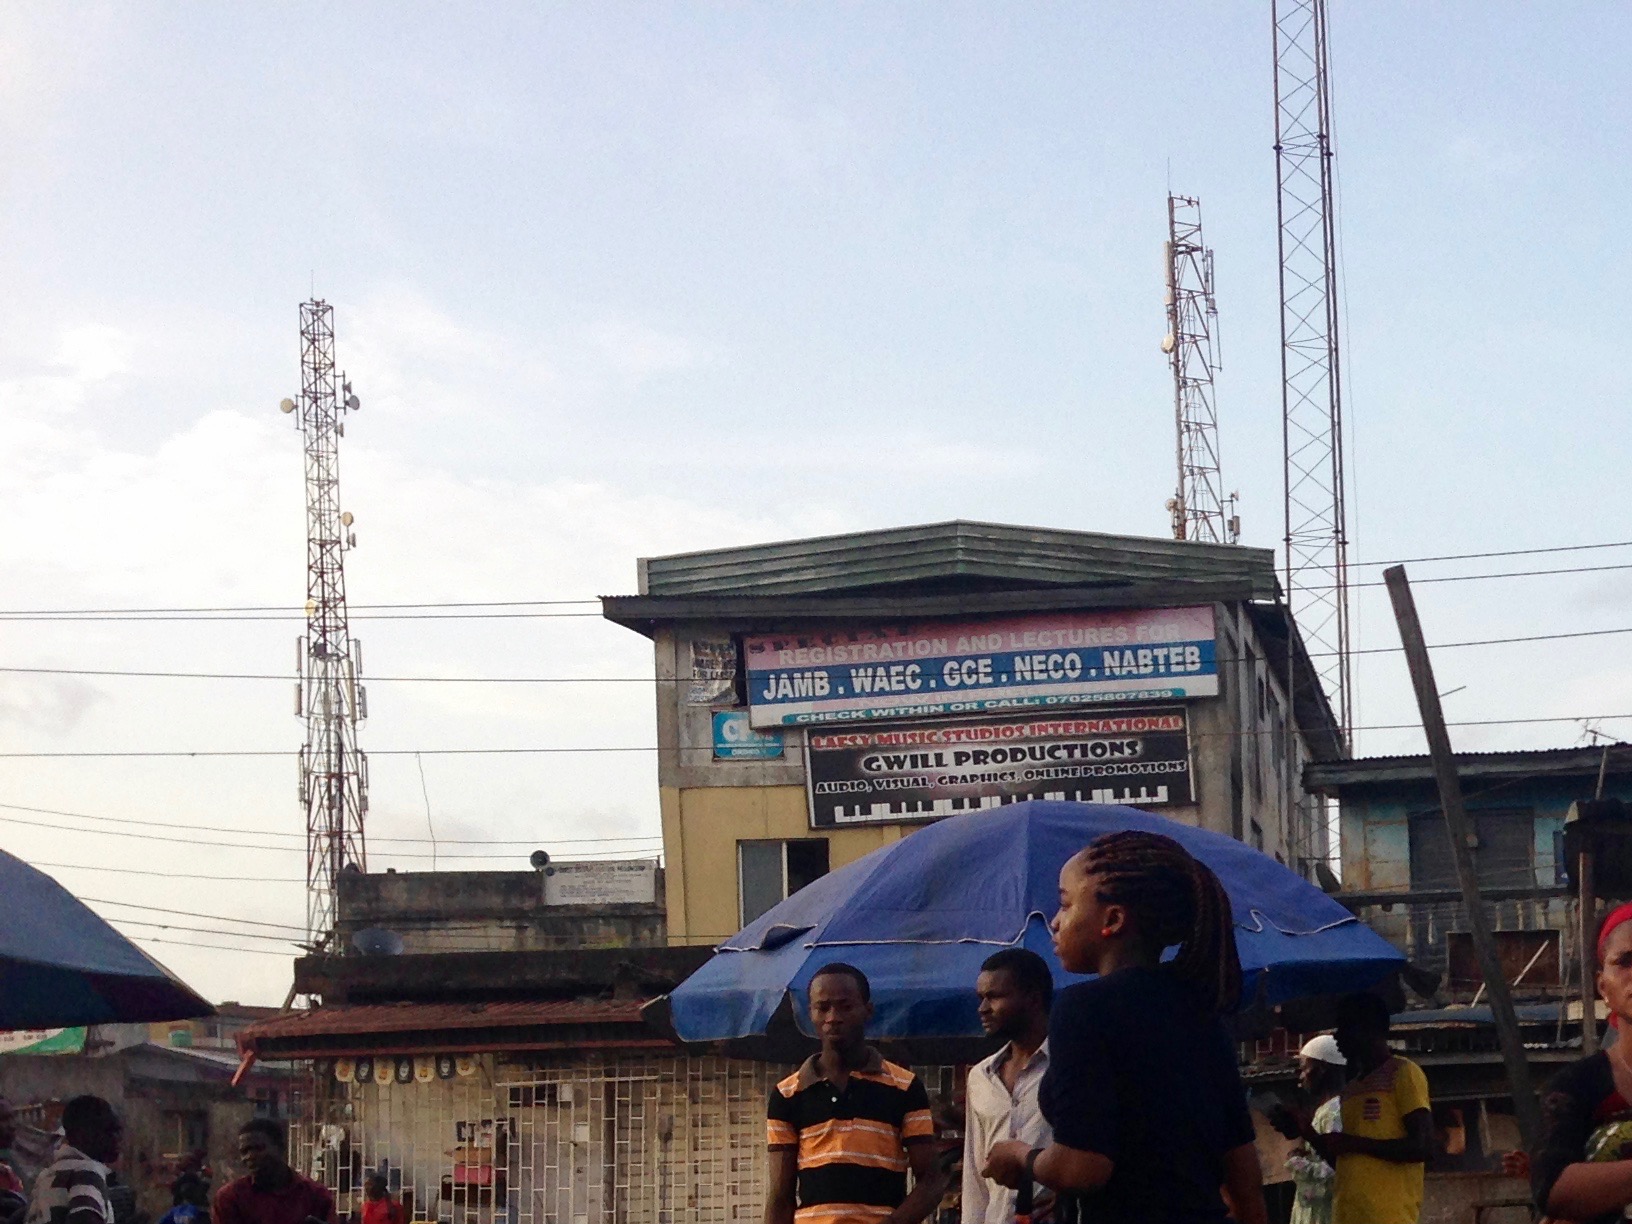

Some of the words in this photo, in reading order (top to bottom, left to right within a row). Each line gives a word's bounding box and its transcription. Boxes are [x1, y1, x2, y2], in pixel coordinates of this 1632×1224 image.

[779, 638, 948, 666] REGISTRATION
[956, 634, 1001, 654] AND
[1009, 626, 1130, 648] LECTURES
[1135, 624, 1180, 642] FOR
[763, 671, 830, 700] JAMB
[850, 664, 922, 693] WAEC
[943, 658, 993, 686] GCE
[1014, 652, 1082, 681] NECO
[1103, 646, 1201, 676] NABTEB
[796, 710, 866, 723] CHECK
[871, 704, 943, 717] WITHIN
[950, 701, 979, 711] OR
[876, 731, 938, 745] MUSIC
[942, 725, 1025, 743] STUDIOS
[1029, 715, 1183, 737] INTERNATIONAL
[863, 752, 948, 772] GWILL
[954, 740, 1139, 767] PRODUCTIONS
[1023, 766, 1080, 780] ONLINE
[1082, 760, 1188, 777] PROMOTIONS
